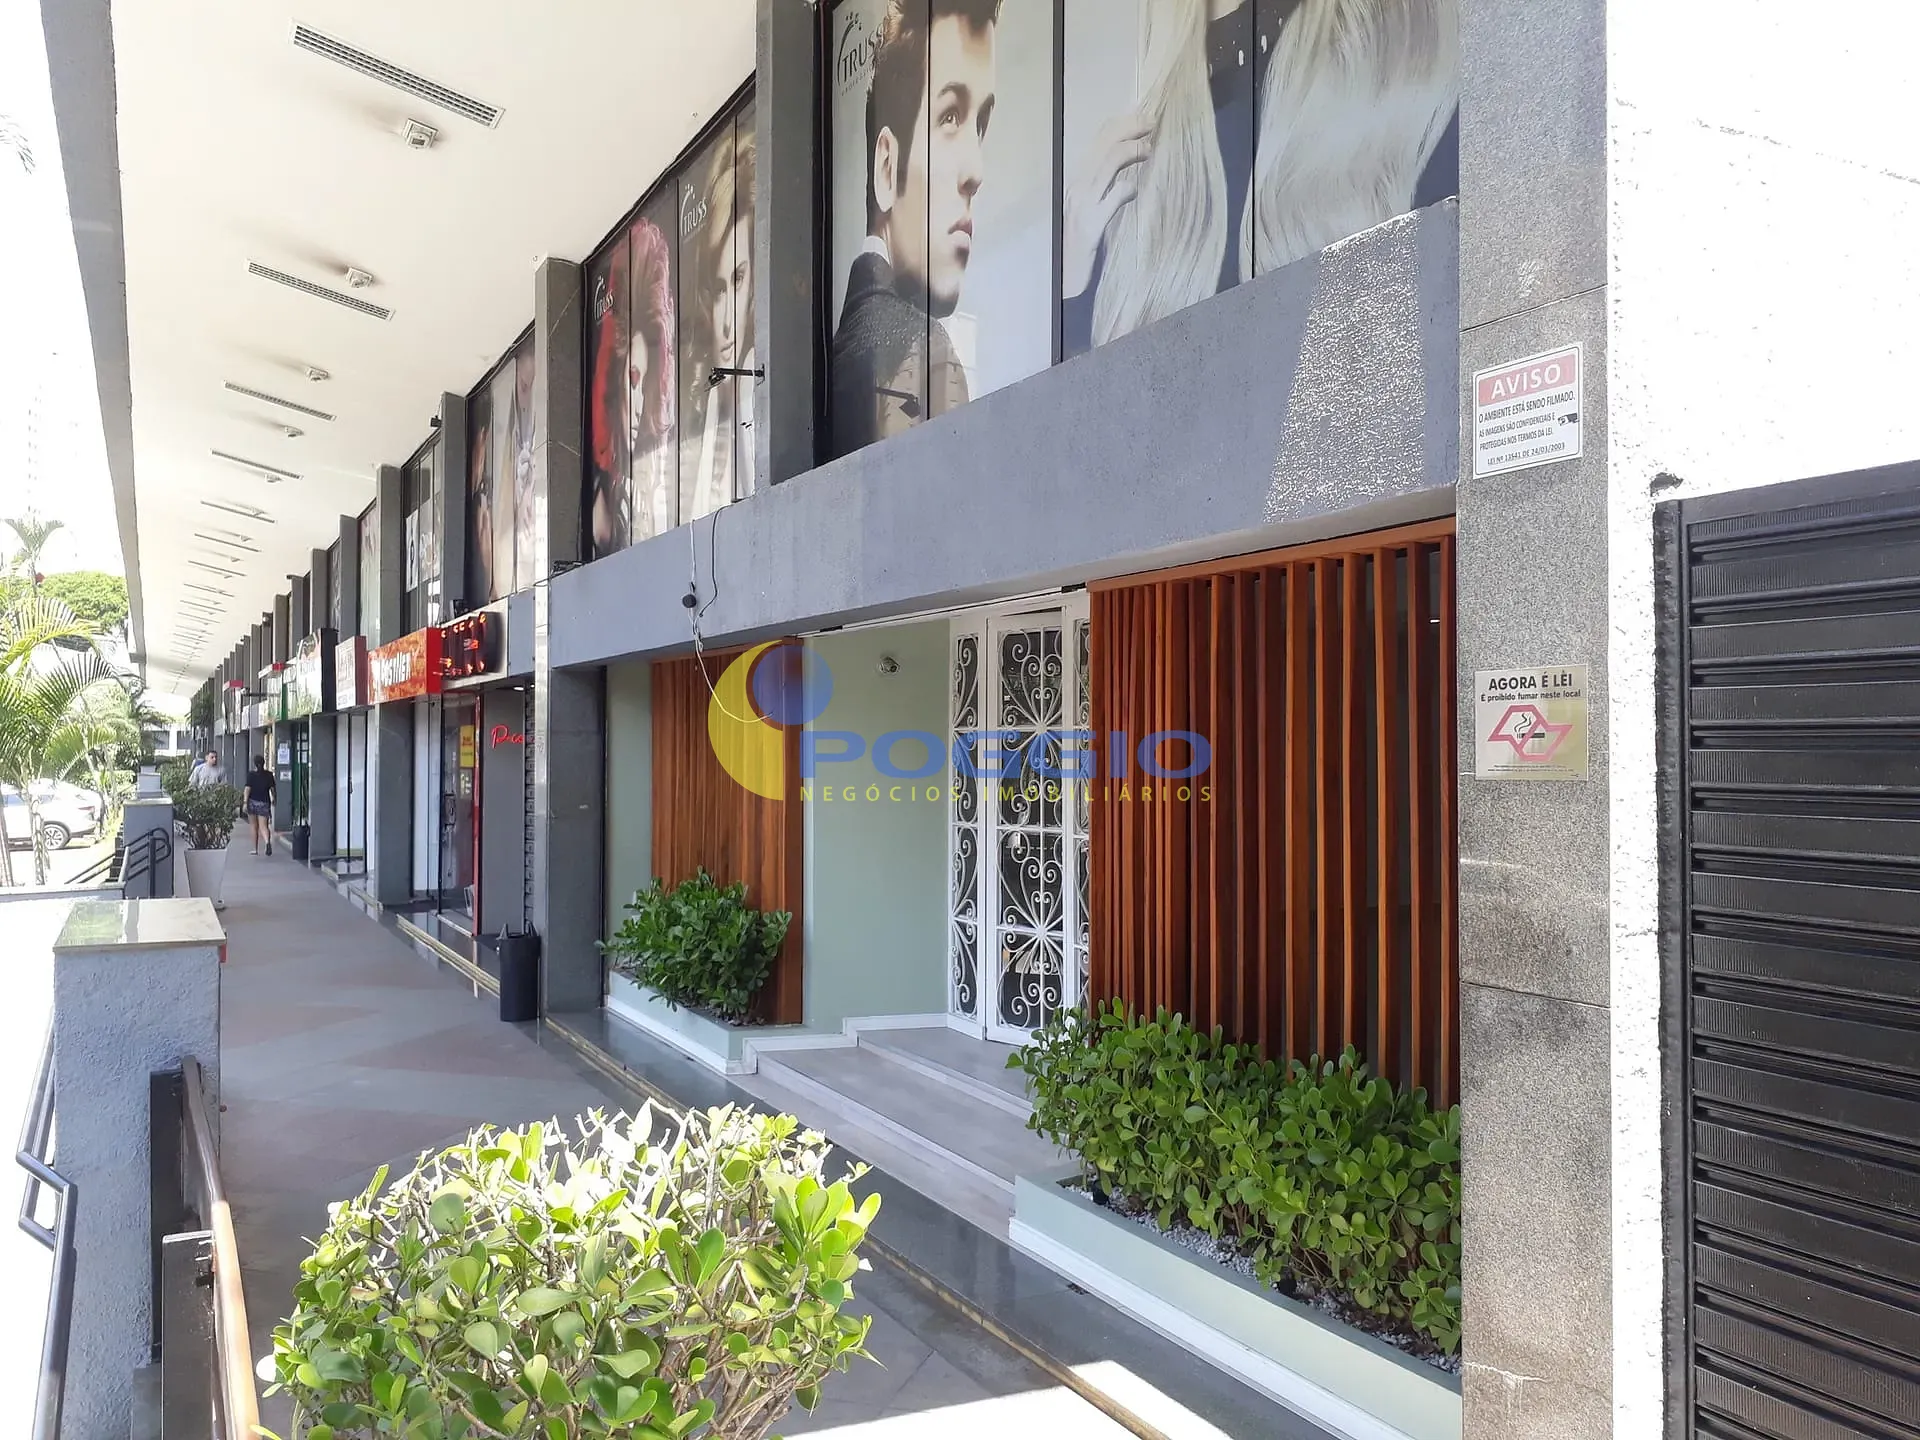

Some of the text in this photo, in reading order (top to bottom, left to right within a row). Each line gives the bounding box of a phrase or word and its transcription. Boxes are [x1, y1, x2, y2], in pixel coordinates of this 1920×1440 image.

[842, 24, 885, 82] TRUSS
[684, 196, 707, 236] TRUSS
[1491, 364, 1560, 400] AVISO
[1479, 391, 1575, 423] O AMBIENTE ESTÁ SENDO FILMADO.
[1479, 429, 1485, 438] AS
[1485, 424, 1505, 436] IMAGENS
[1506, 420, 1515, 431] SÃO
[1516, 414, 1551, 429] CONFIDENCIAIS
[1480, 438, 1506, 451] PROTEGIDAS
[1507, 435, 1517, 444] NOS
[1517, 431, 1537, 442] TERMOS
[1538, 429, 1544, 438] DA
[1523, 449, 1530, 457] DE
[1489, 675, 1537, 691] AGORA
[1542, 671, 1549, 688] É
[1488, 693, 1516, 703] proibido
[1518, 692, 1538, 700] fumar
[1540, 691, 1560, 699] neste
[1563, 689, 1581, 698] local
